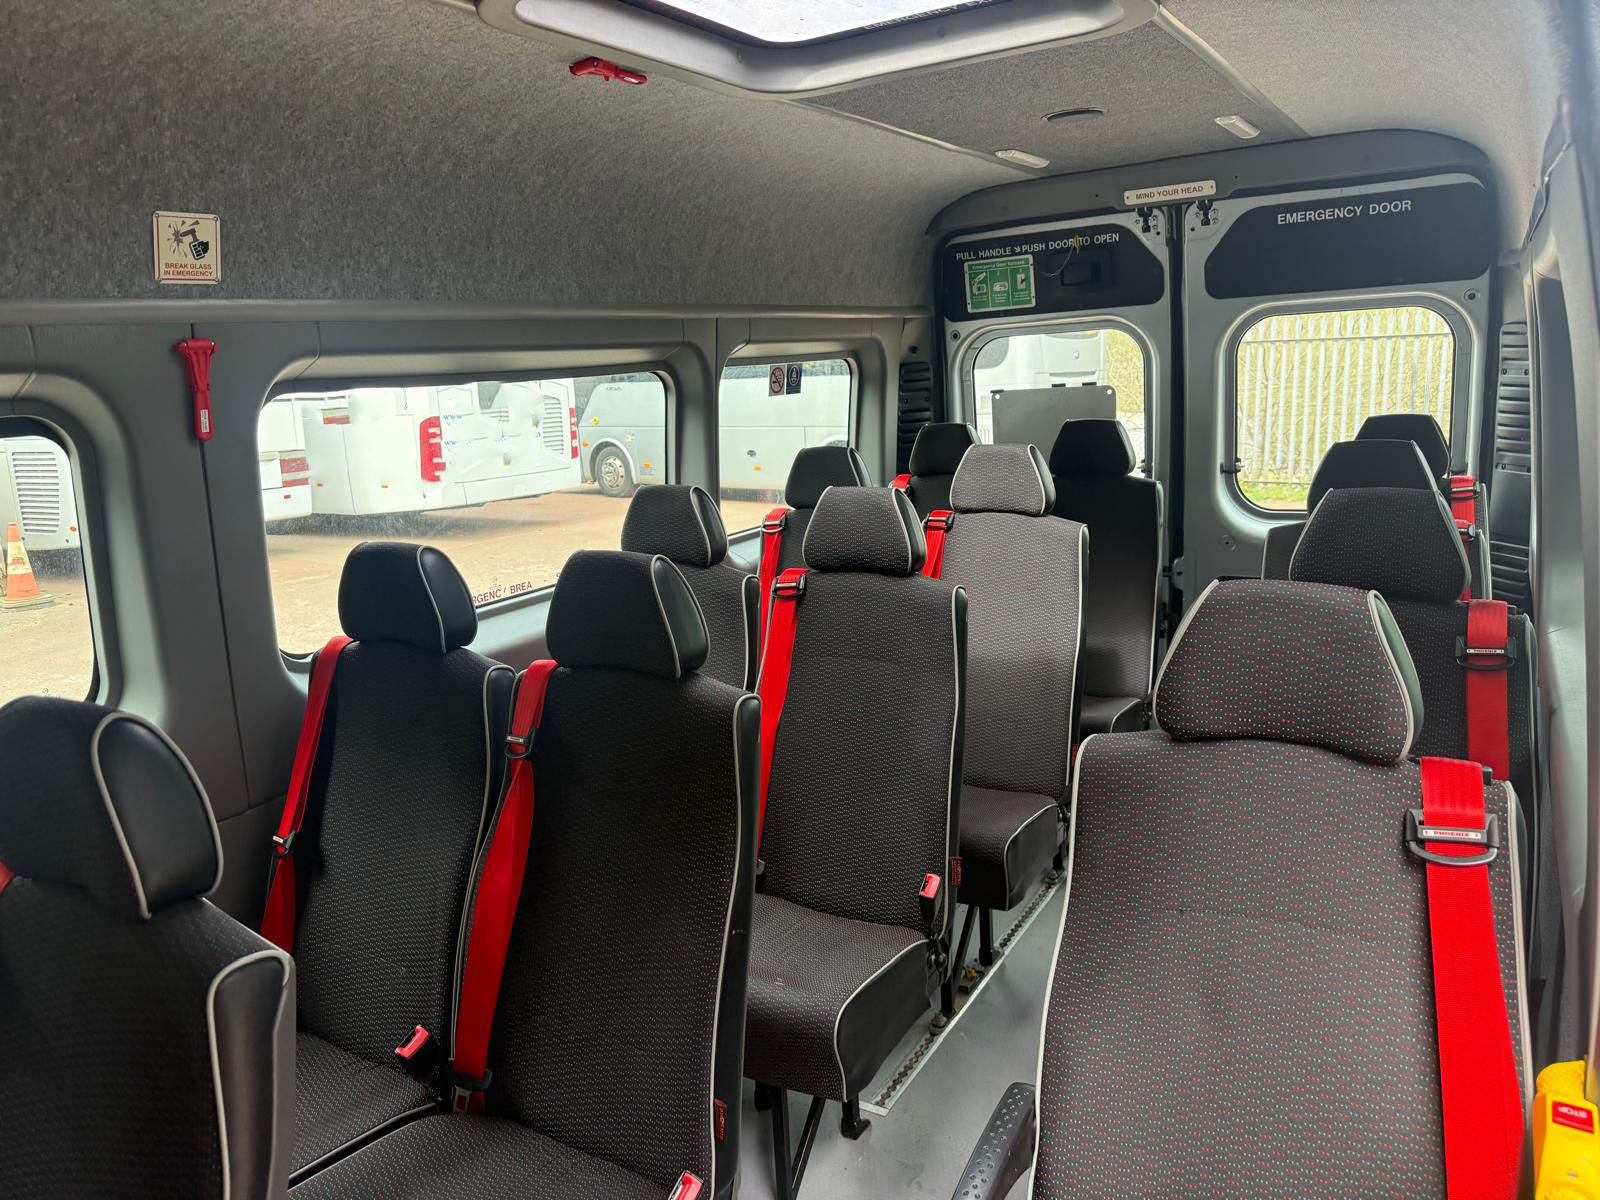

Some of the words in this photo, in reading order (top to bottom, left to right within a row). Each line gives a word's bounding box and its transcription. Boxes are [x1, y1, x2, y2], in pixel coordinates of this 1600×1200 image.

[1135, 191, 1155, 200] MIND
[1157, 188, 1179, 198] YOUR
[1181, 185, 1203, 195] HEAD
[1277, 205, 1364, 225] EMERGENCY
[1369, 200, 1411, 215] DOOR
[956, 252, 976, 261] PULL
[978, 247, 1012, 259] HANDLE
[1022, 243, 1046, 253] PUSH
[1049, 240, 1074, 250] DOOR
[1078, 236, 1091, 246] TO
[1094, 233, 1119, 244] OPEN
[510, 581, 532, 594] BREA
